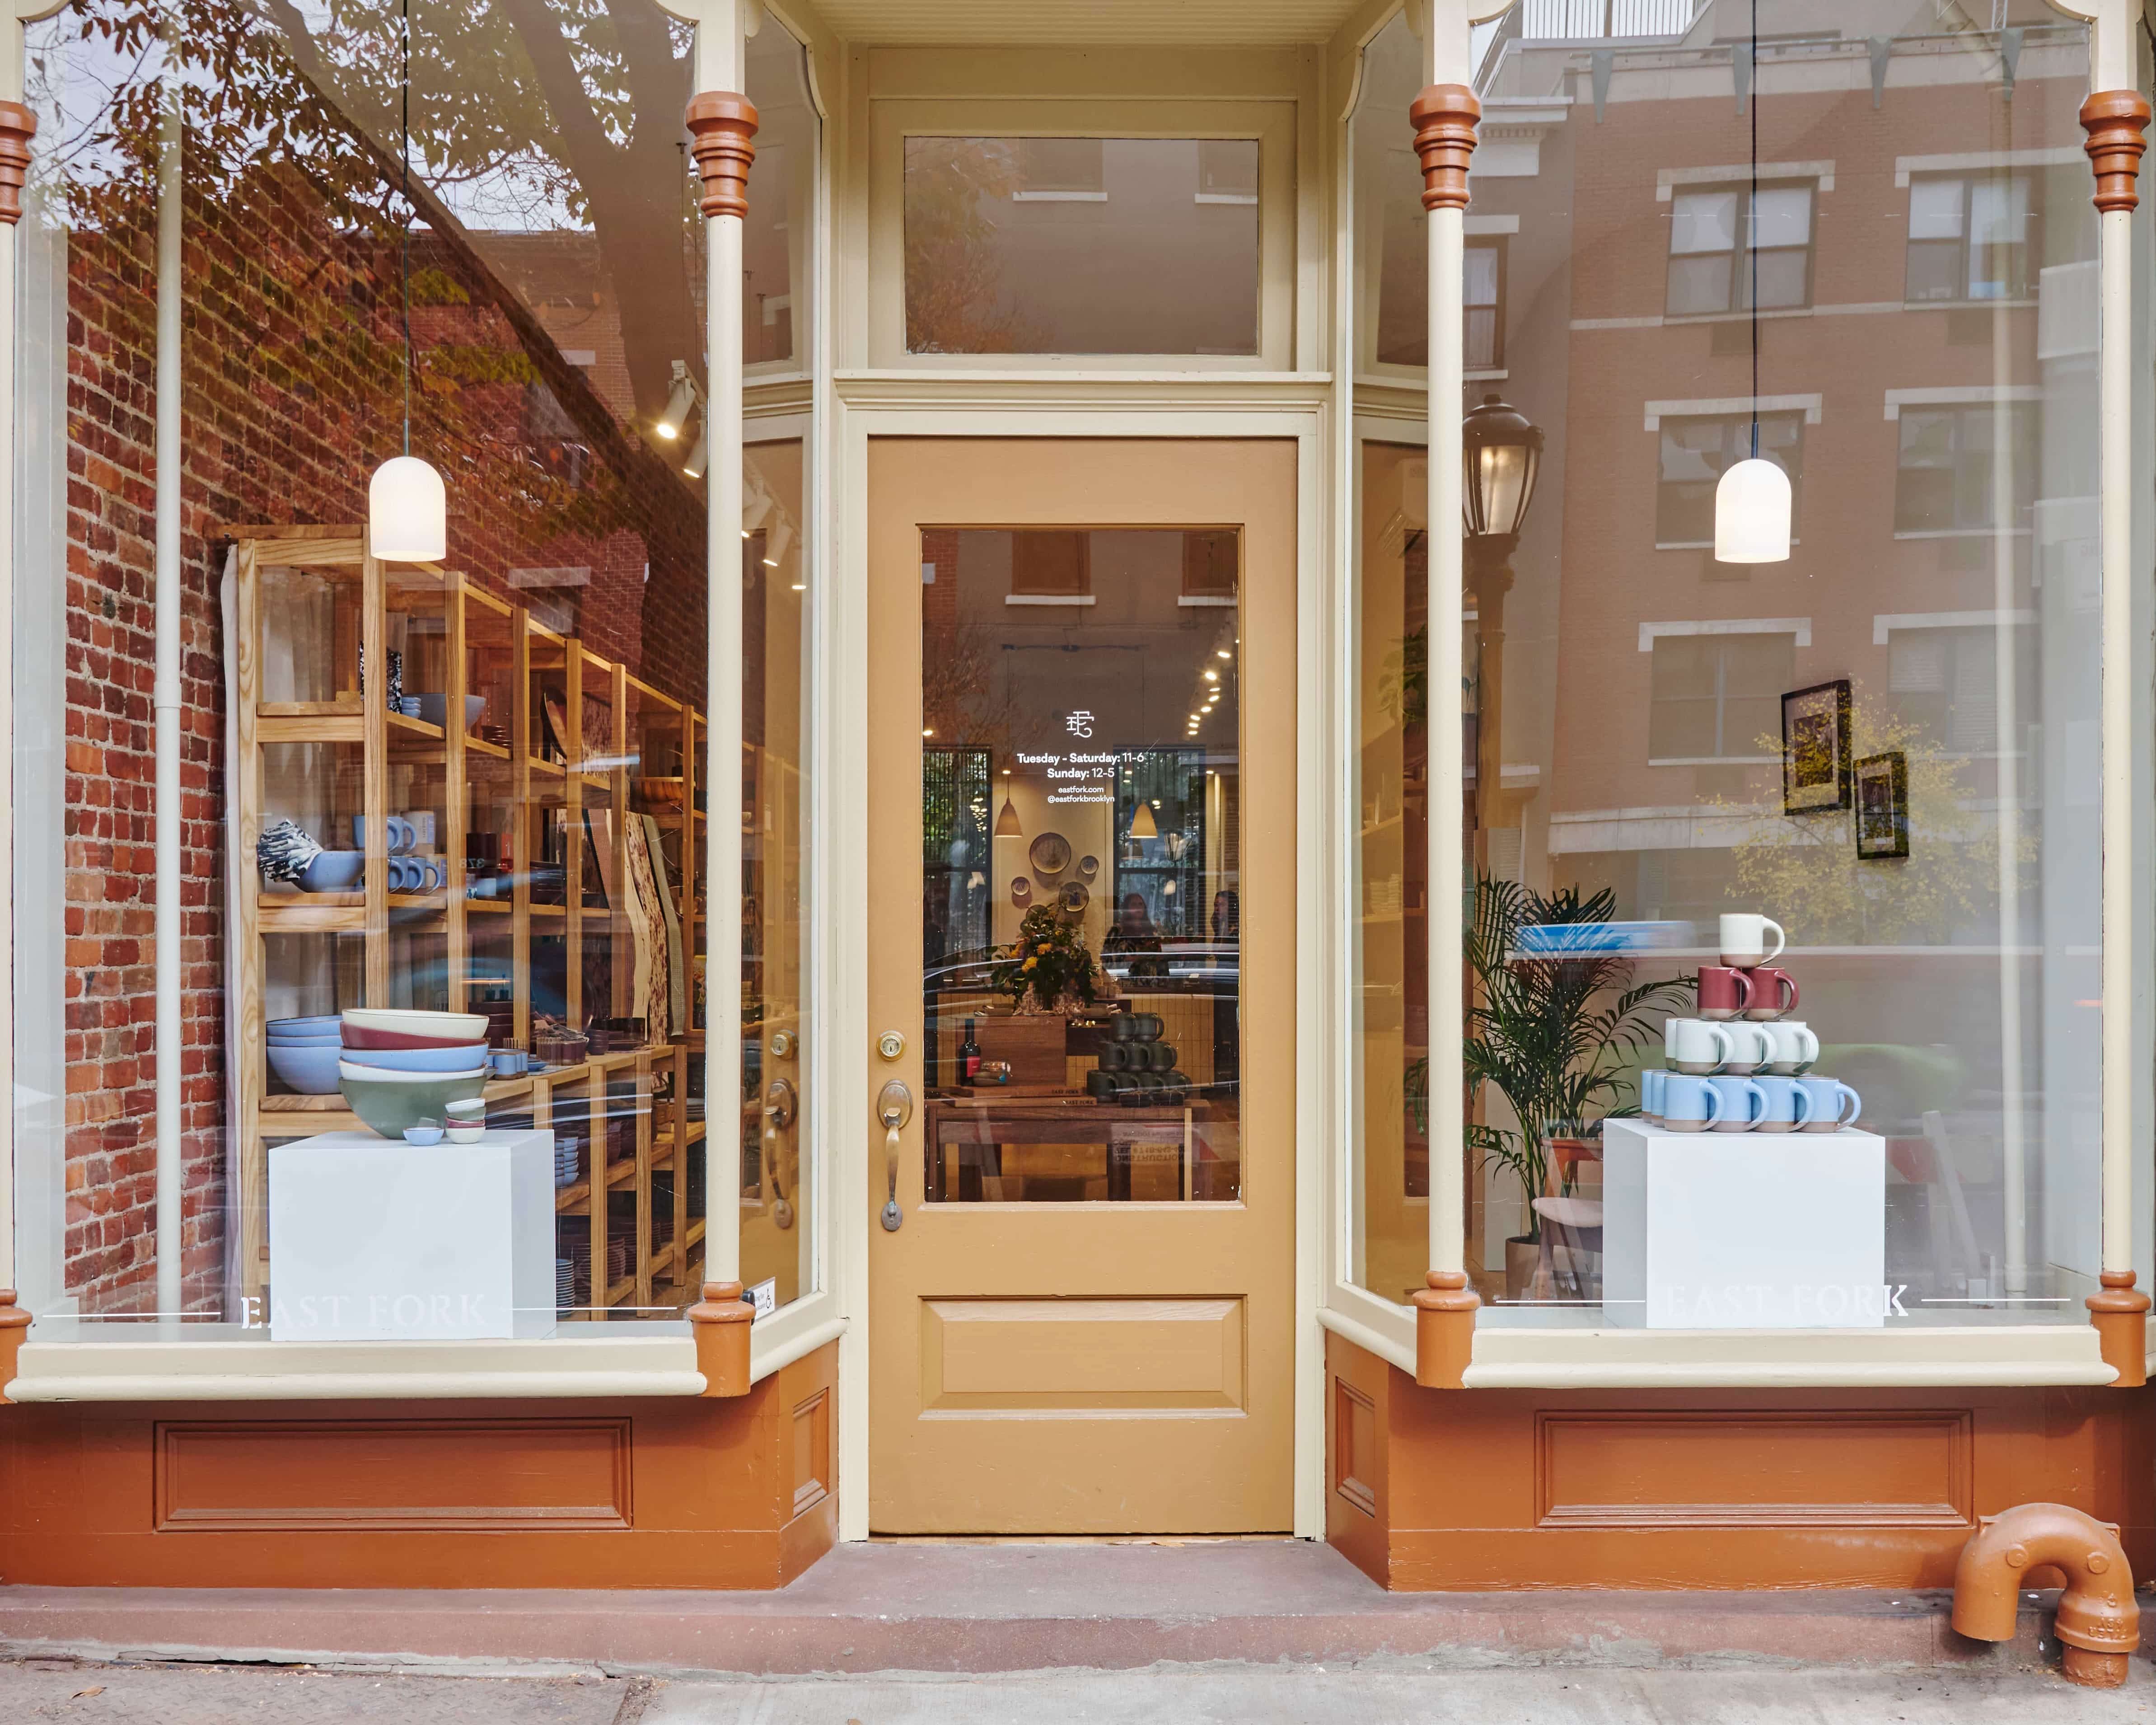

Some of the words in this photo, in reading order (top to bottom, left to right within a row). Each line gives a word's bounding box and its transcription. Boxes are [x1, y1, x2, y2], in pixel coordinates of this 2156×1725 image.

[1017, 753, 1060, 765] Tuesday
[1070, 753, 1120, 765] Saturday:
[1122, 753, 1144, 762] 11-6
[1048, 768, 1090, 780] Sunday:
[1091, 768, 1115, 778] 12-5
[1048, 795, 1115, 804] @eastforkbrooklyn
[1667, 1284, 1773, 1316] EAST
[1792, 1284, 1908, 1317] FORK
[241, 1294, 351, 1329] EAST
[368, 1294, 488, 1327] FORK
